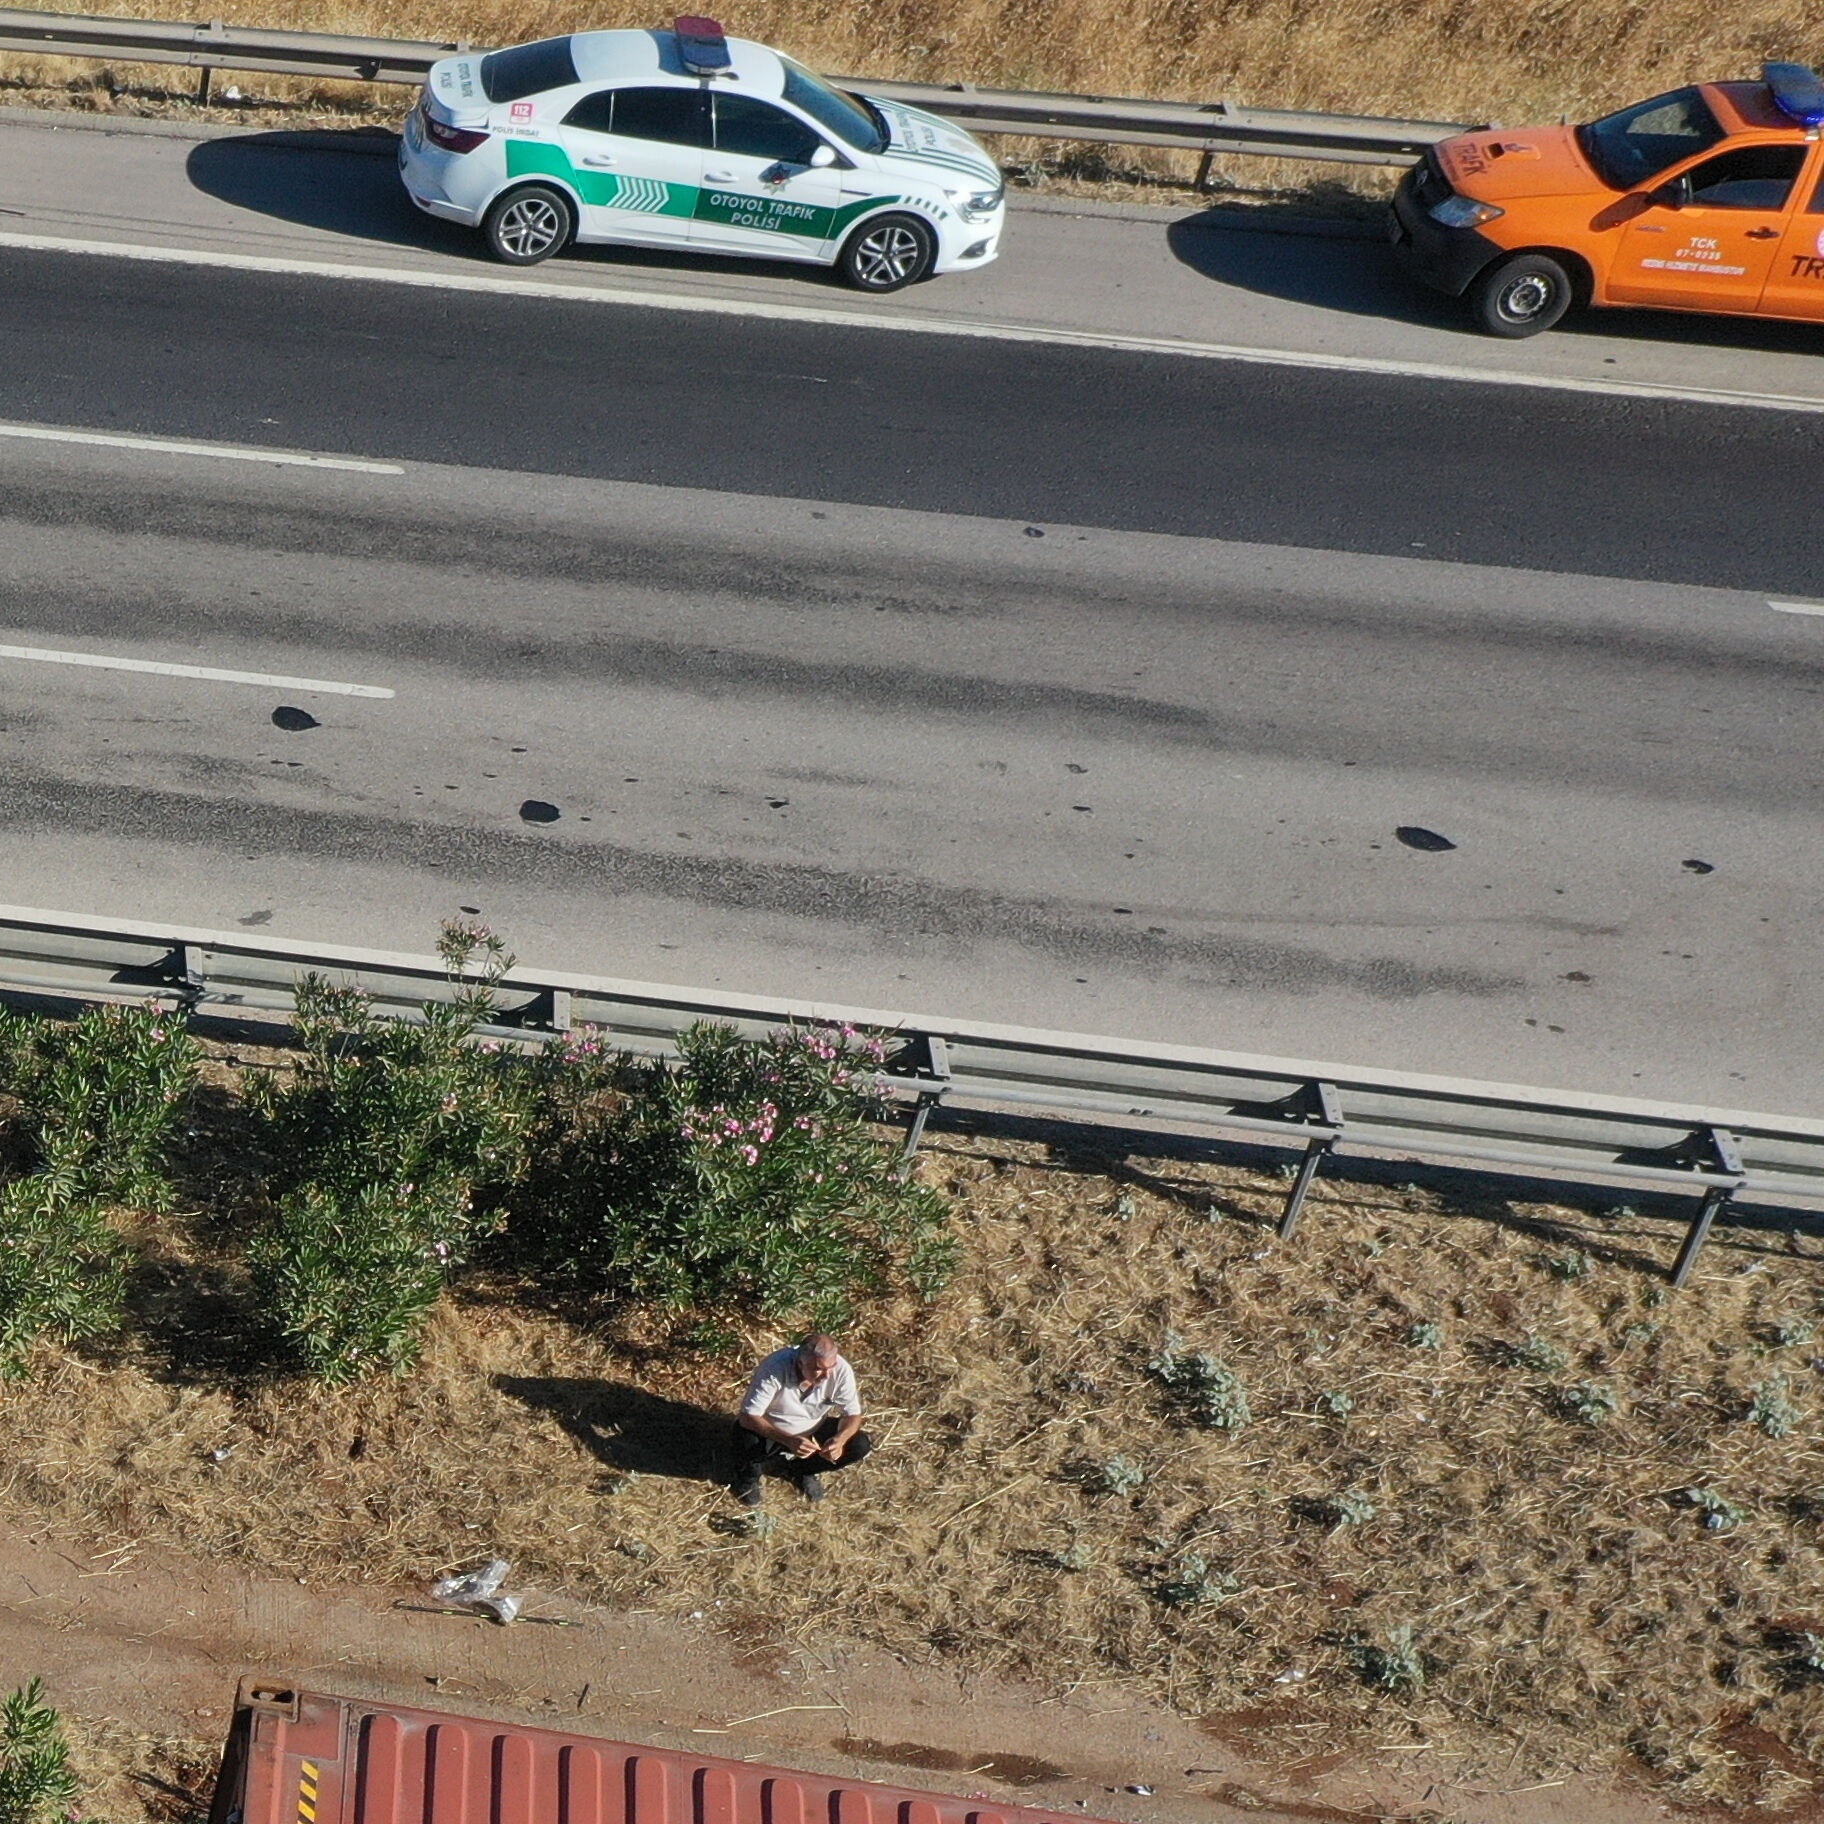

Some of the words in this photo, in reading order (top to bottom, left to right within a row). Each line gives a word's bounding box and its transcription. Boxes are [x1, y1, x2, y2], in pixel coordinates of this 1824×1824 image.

[710, 194, 764, 212] OTOYOL
[731, 212, 782, 230] POLİSİ
[1690, 237, 1718, 249] TCK
[1791, 255, 1824, 279] TR
